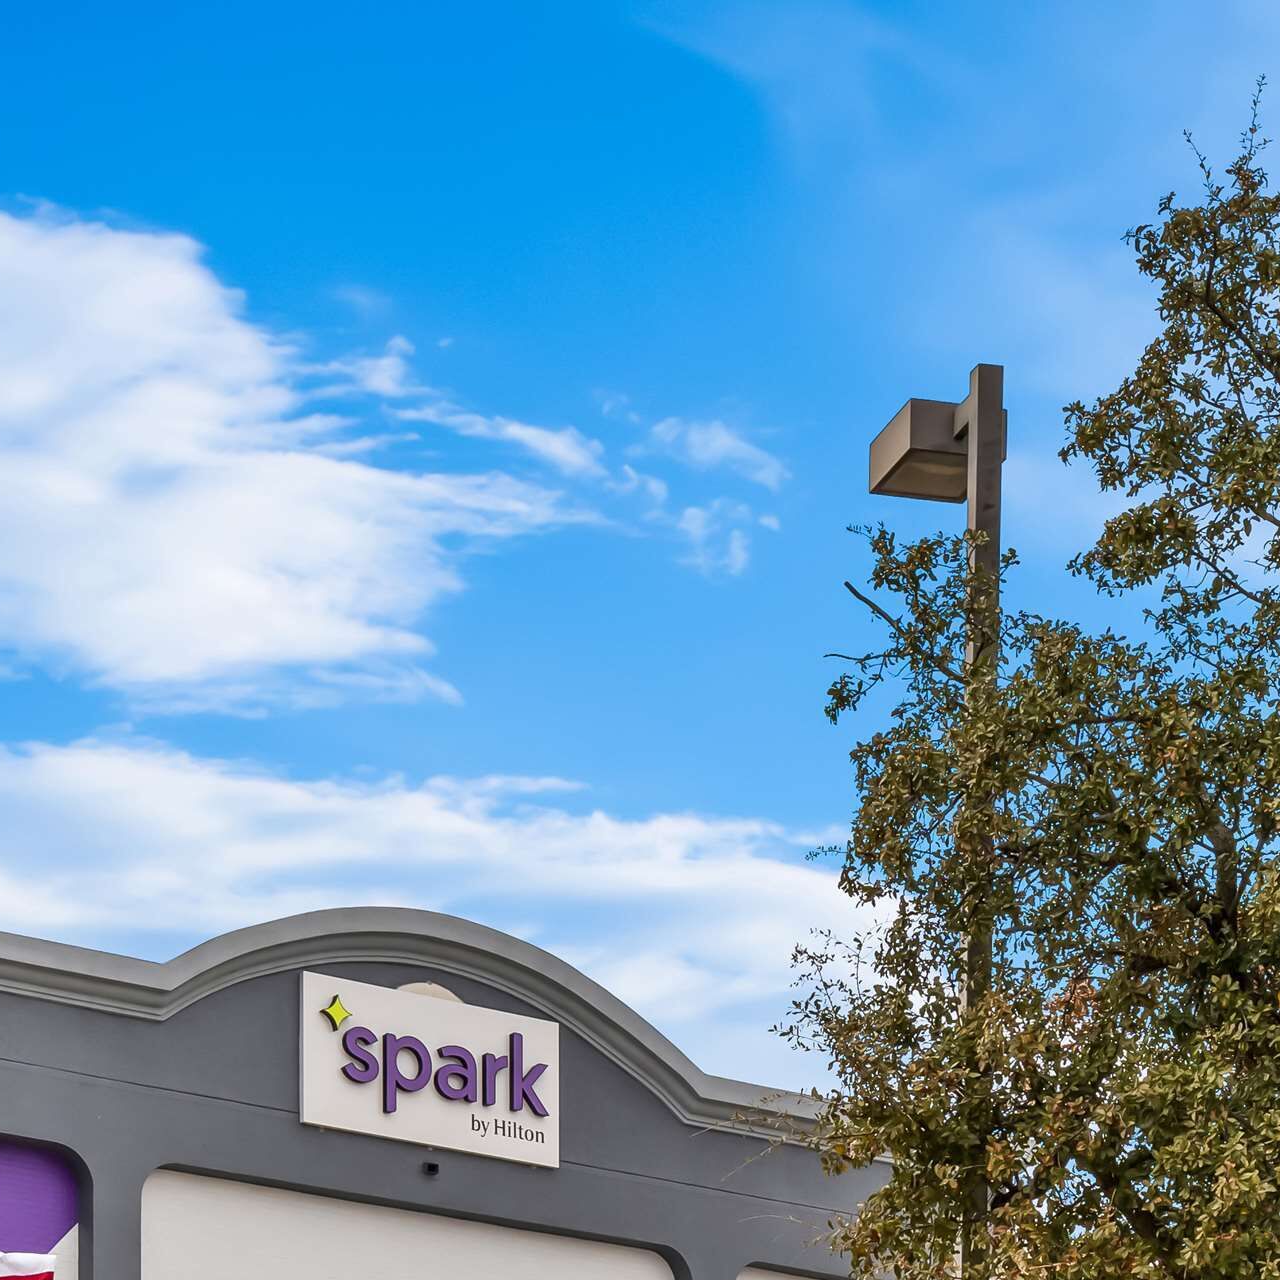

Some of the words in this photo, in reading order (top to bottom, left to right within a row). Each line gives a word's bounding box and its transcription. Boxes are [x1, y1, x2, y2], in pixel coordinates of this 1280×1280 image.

[340, 1026, 550, 1117] spark
[471, 1114, 490, 1137] by
[494, 1117, 545, 1144] Hilton
